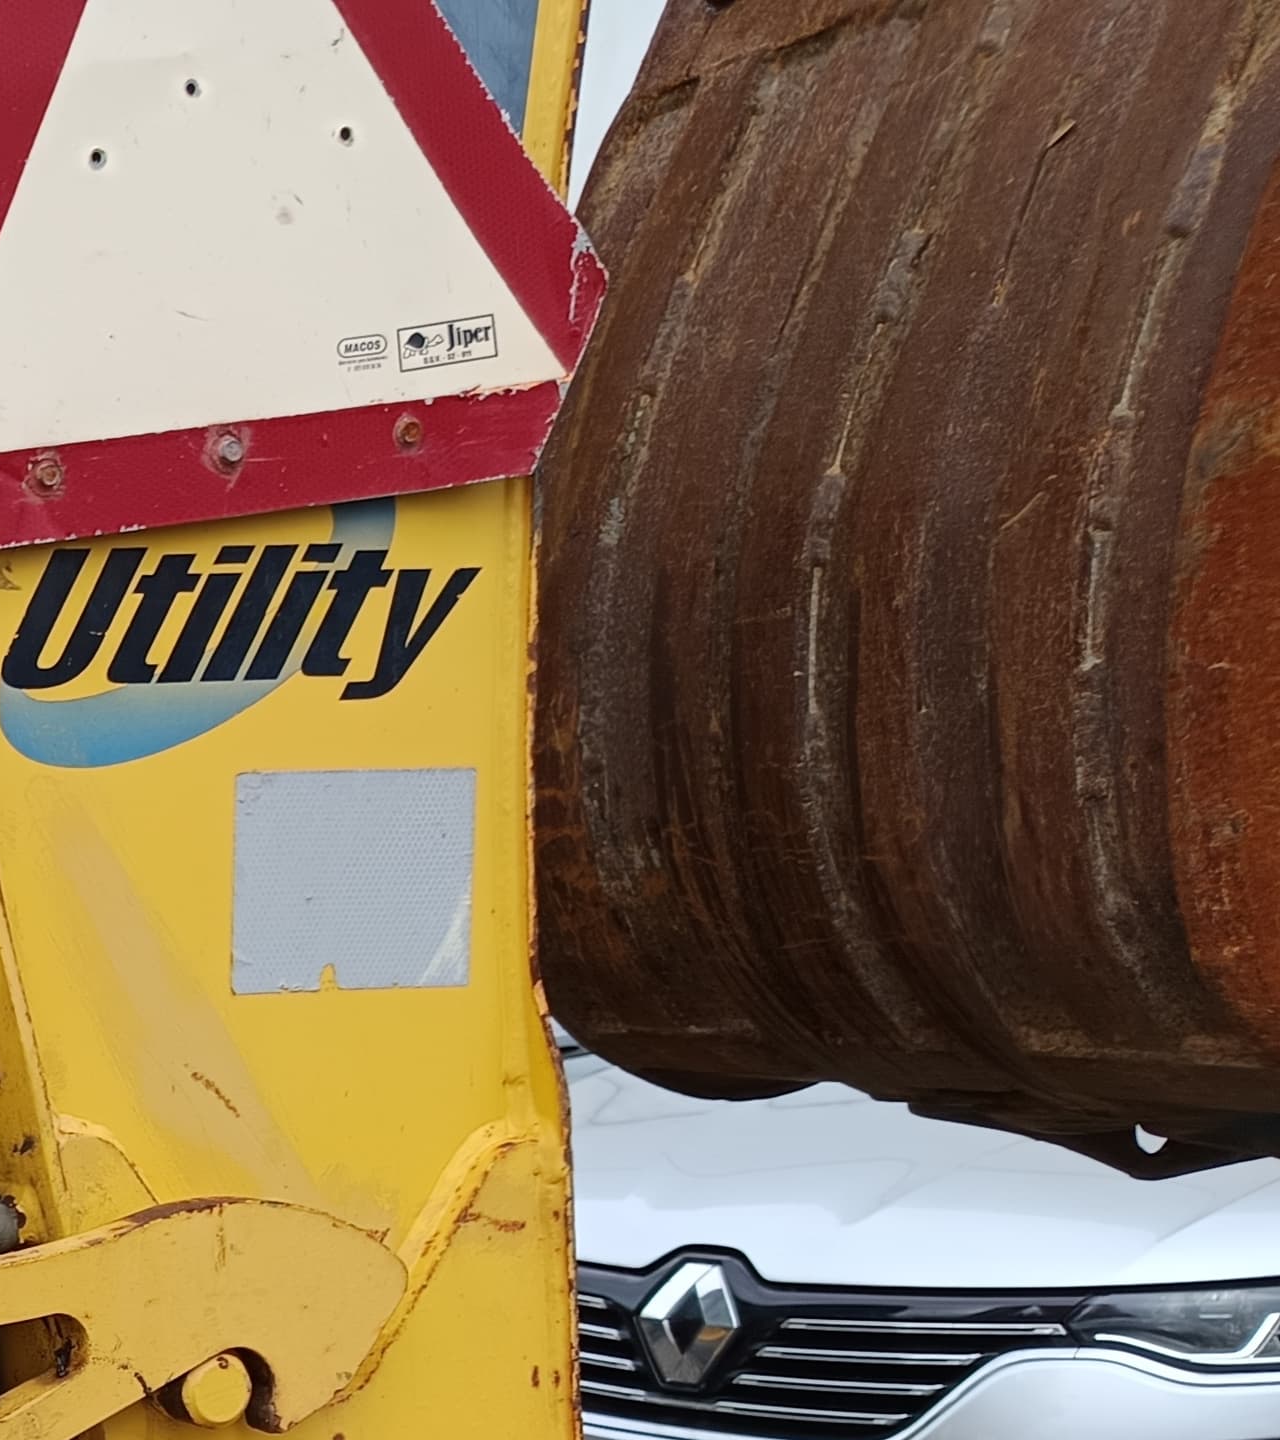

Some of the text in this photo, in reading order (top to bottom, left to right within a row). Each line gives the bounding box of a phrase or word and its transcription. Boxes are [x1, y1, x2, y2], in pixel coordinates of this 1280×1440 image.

[343, 340, 382, 353] MACOS
[446, 323, 492, 352] Jiper
[0, 543, 482, 701] Utility
